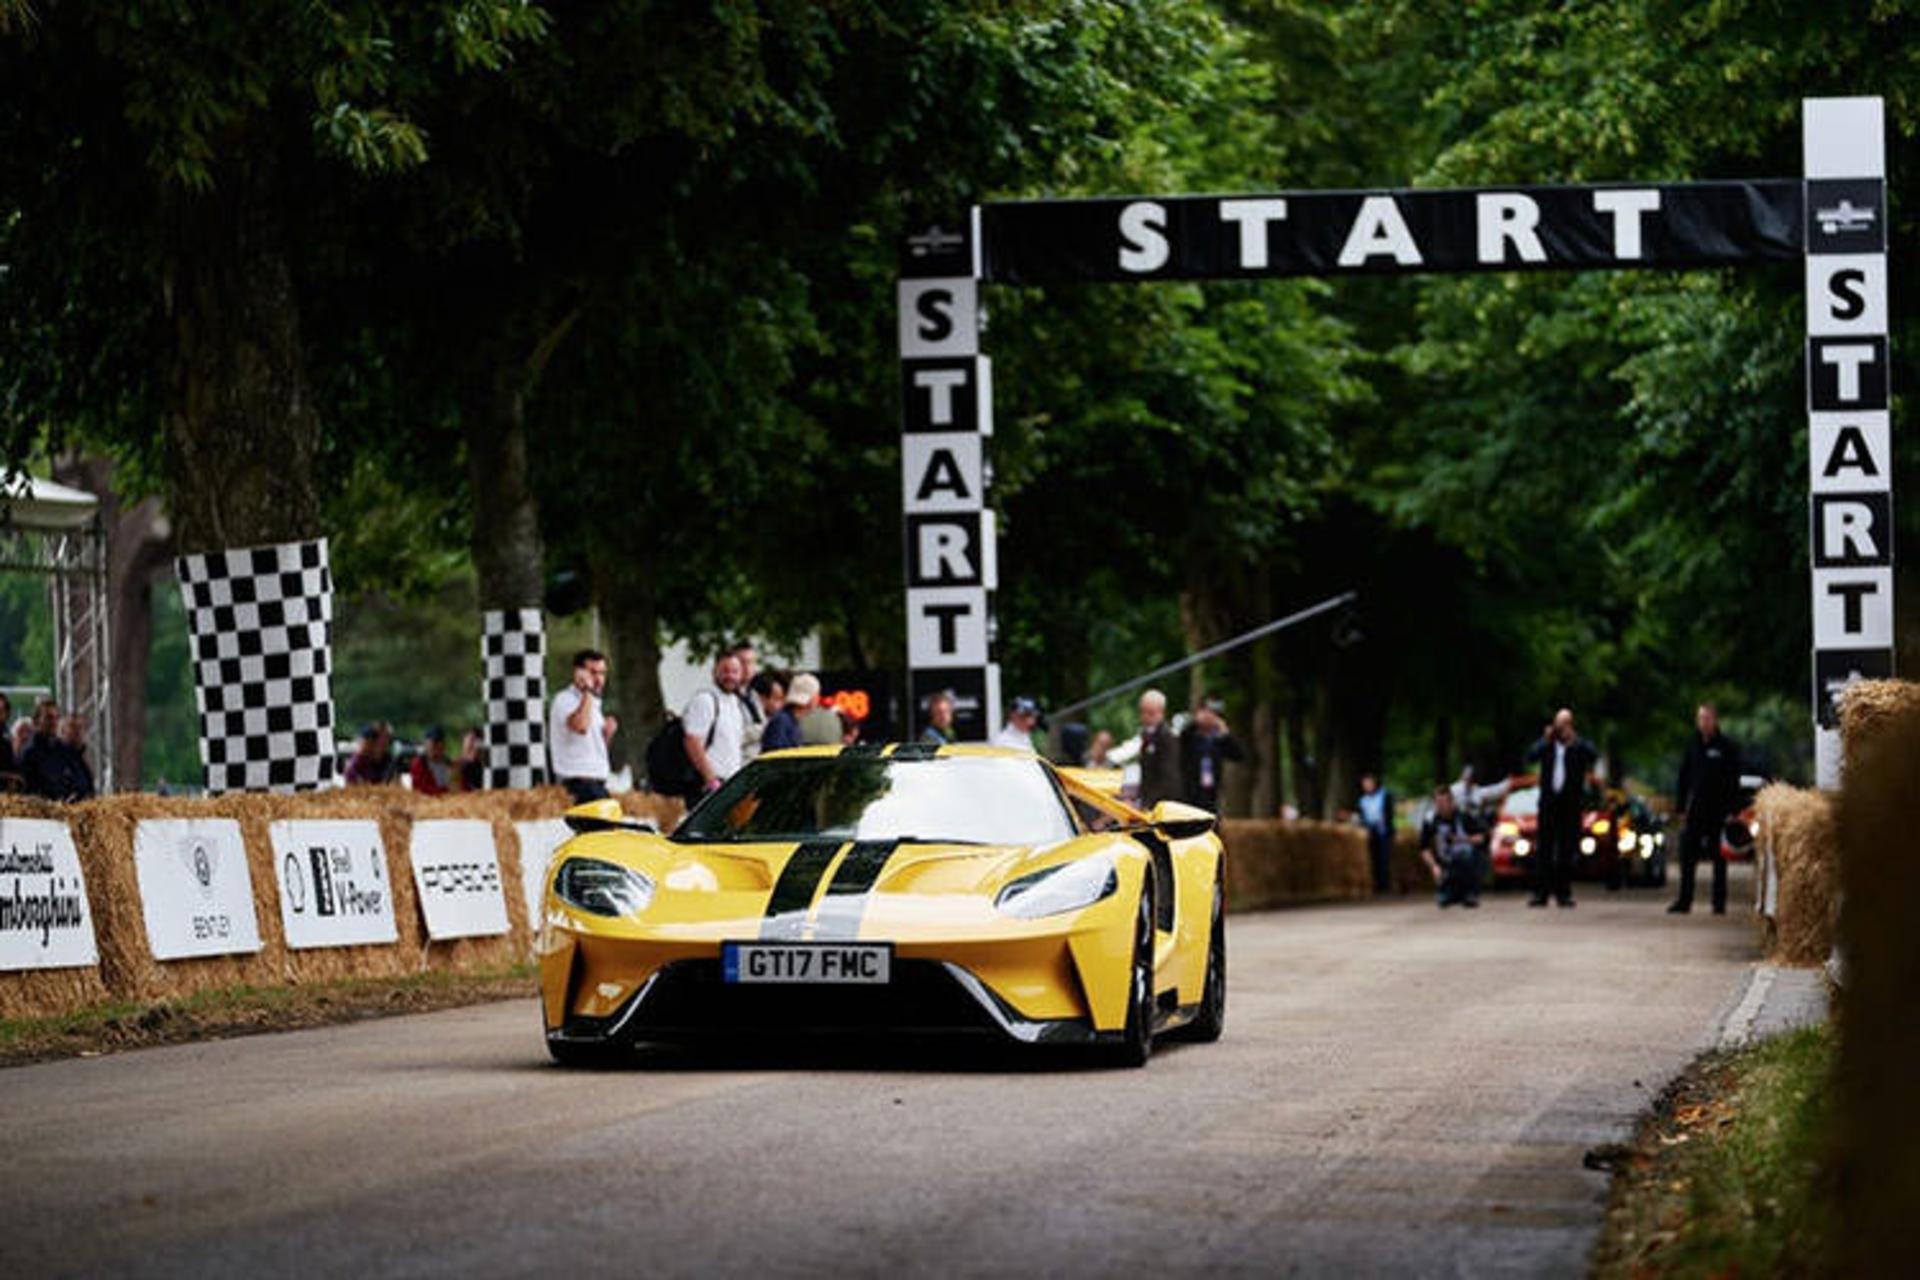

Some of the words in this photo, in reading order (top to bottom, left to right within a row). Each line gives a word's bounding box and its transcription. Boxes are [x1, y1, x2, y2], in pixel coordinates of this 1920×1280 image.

[1118, 189, 1660, 274] START
[914, 287, 975, 654] START
[1821, 268, 1879, 635] START
[750, 950, 813, 977] GT17
[821, 950, 878, 978] FMC
